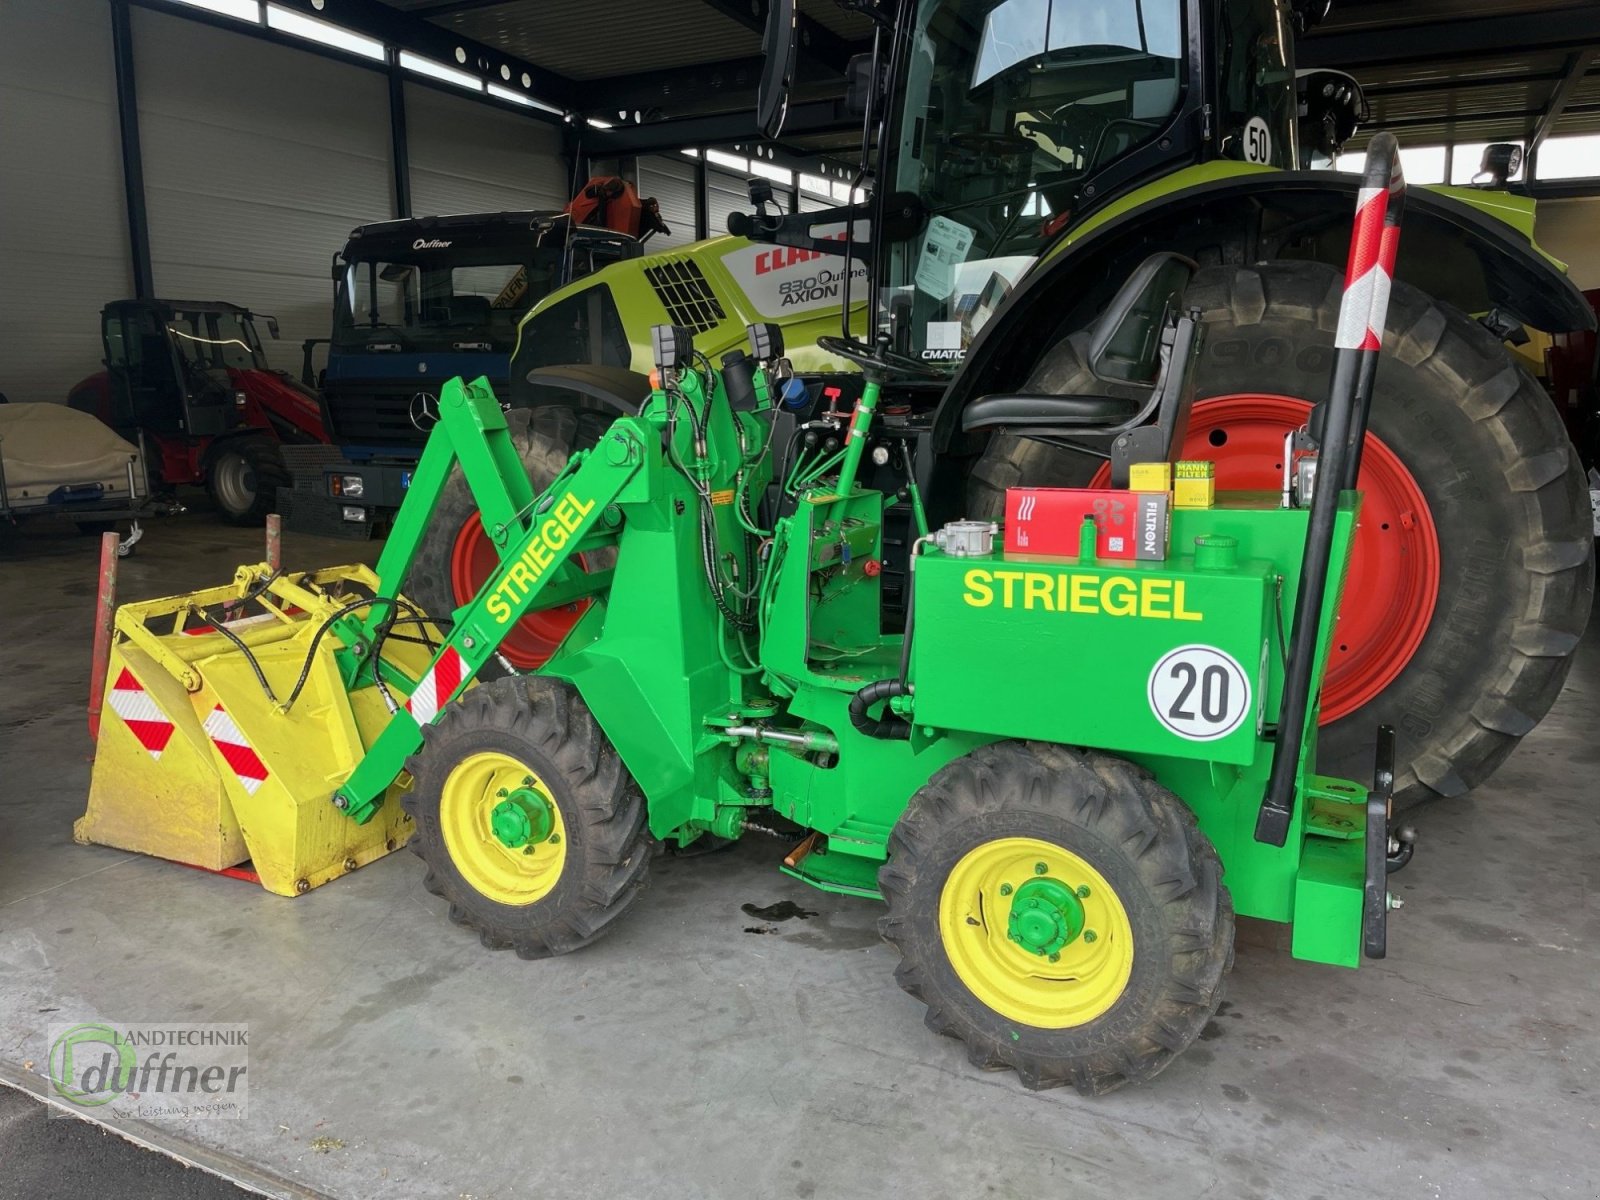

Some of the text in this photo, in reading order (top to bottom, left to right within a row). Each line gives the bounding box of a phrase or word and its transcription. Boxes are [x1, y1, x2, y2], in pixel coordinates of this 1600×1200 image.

[1249, 126, 1267, 163] 50
[412, 238, 452, 250] Duffner
[779, 277, 817, 295] 830
[781, 284, 838, 306] AXION
[921, 349, 967, 360] CMATIC
[1177, 464, 1208, 472] MANN
[1177, 471, 1208, 479] FILTER
[1110, 498, 1125, 526] AP
[1144, 502, 1158, 551] FILTRON
[486, 491, 596, 624] STRIEGEL
[964, 569, 1203, 621] STRIEGEL
[1169, 662, 1229, 723] 20
